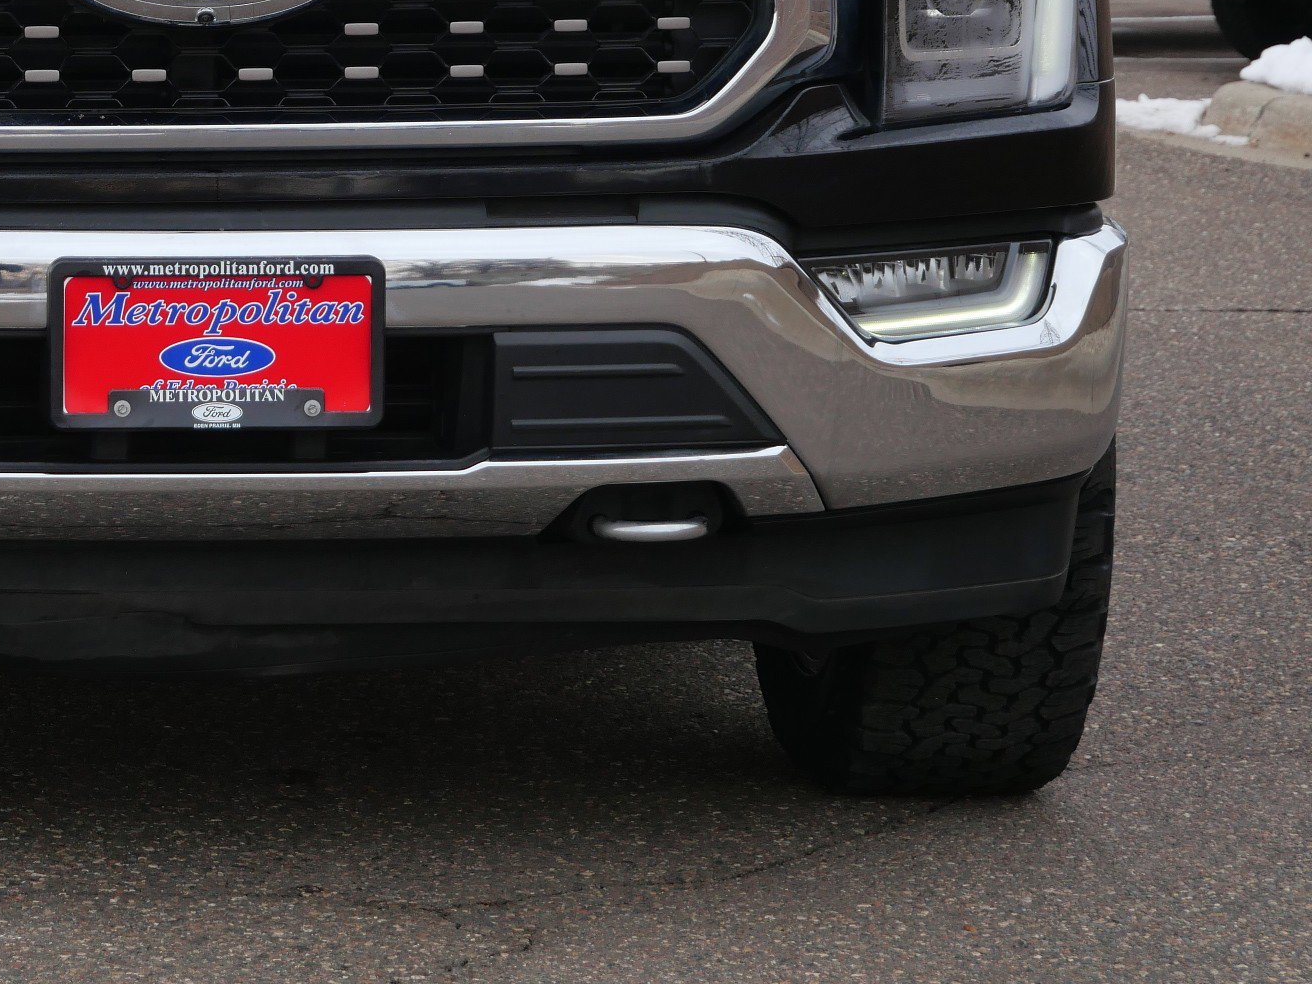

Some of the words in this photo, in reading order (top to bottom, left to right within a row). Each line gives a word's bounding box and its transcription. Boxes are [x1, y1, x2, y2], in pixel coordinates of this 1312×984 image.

[102, 261, 335, 278] www.metropolitanford.com
[133, 279, 304, 291] www.metropolitanford.com
[72, 289, 364, 335] Metropolitan
[185, 344, 250, 369] Ford
[150, 389, 285, 402] METROPOLITAN
[204, 405, 233, 418] Ford
